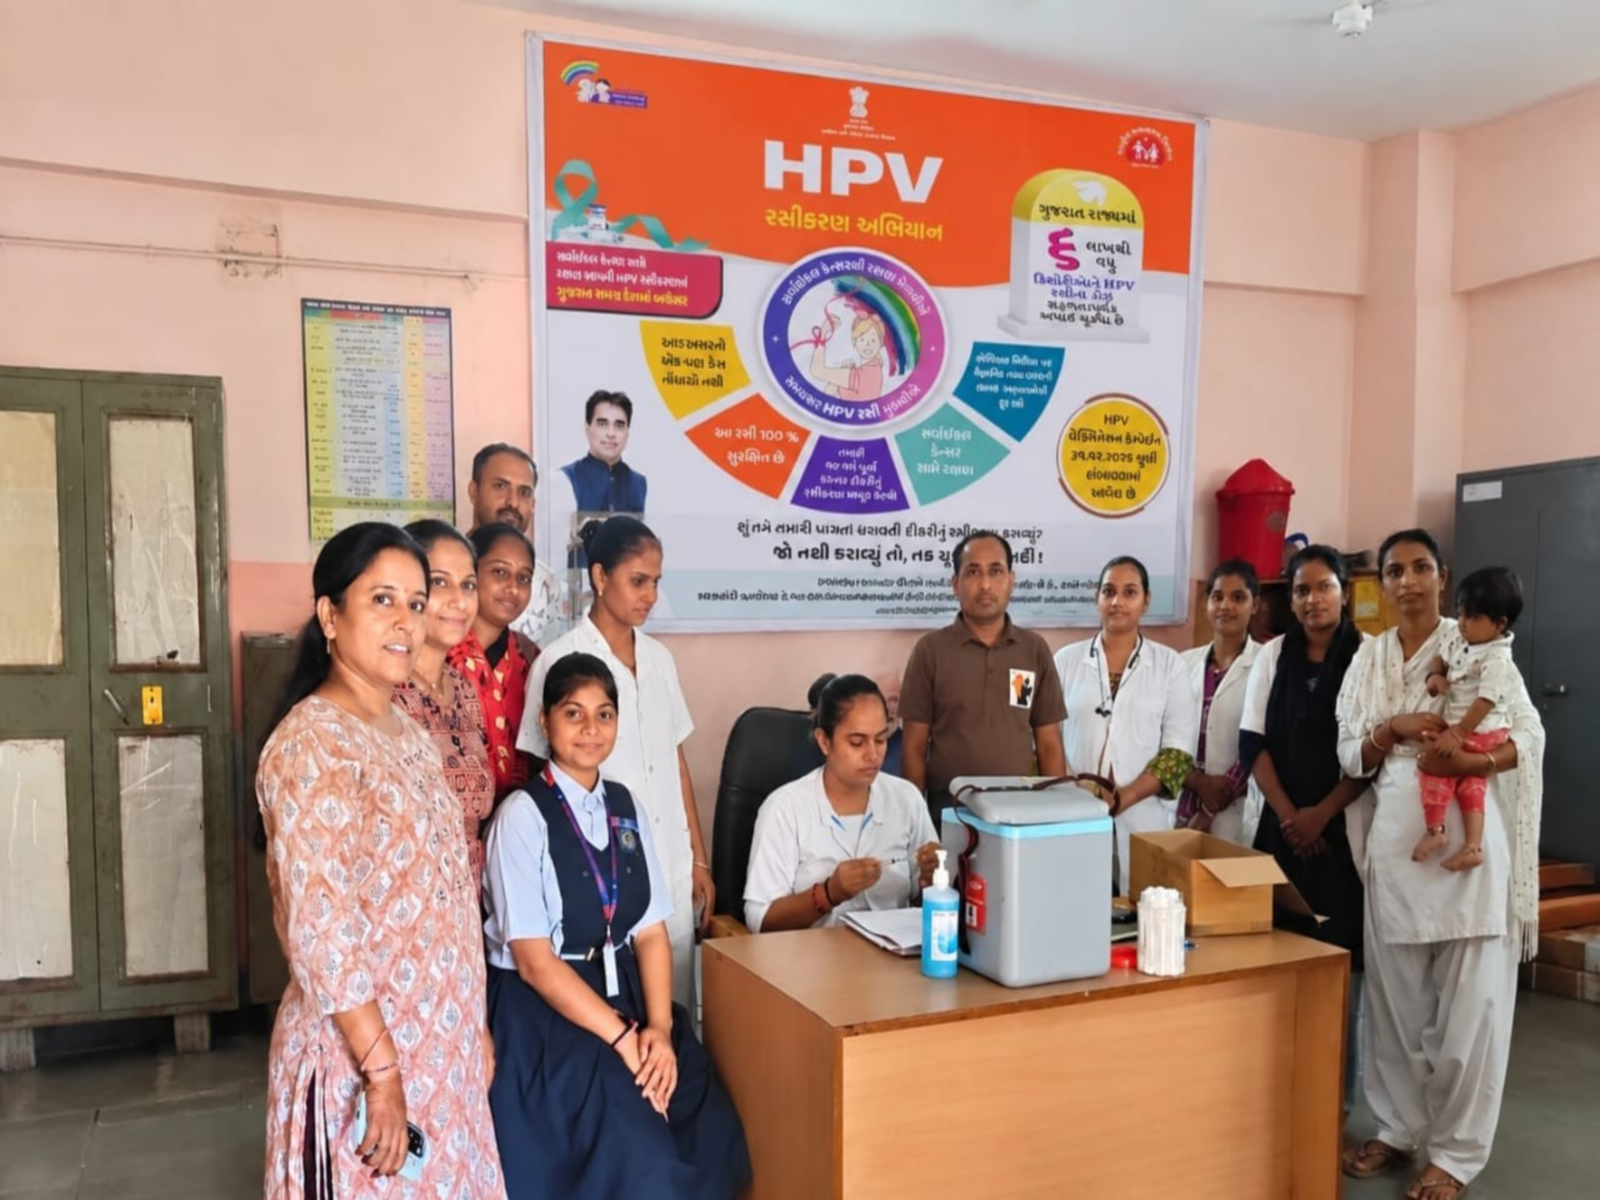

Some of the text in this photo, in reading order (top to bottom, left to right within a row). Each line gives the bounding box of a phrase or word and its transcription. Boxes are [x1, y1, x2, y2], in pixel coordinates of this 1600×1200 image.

[764, 139, 943, 203] HPV
[765, 204, 942, 241] રસીકરણ અભિયાન
[1039, 204, 1136, 224] ગુજરાત રાજ્યમાં
[616, 273, 638, 286] HPV
[1104, 279, 1135, 291] HPV
[701, 374, 723, 388] નથી
[823, 403, 855, 419] HPV
[857, 402, 881, 420] રસી
[1104, 414, 1129, 426] HPV
[714, 427, 732, 439] આ
[735, 424, 756, 440] રસી
[759, 430, 783, 442] 100
[773, 449, 785, 464] છે
[1125, 485, 1136, 499] છે
[737, 519, 750, 538] શું
[751, 519, 772, 534] તમે
[775, 519, 812, 535] તમારી
[856, 521, 901, 537] ધરાવતી
[905, 522, 946, 542] દીકરીનું
[773, 540, 792, 560] જો
[797, 542, 830, 561] નથી
[834, 544, 882, 567] કરાવ્યું
[886, 543, 907, 565] તો,
[911, 549, 934, 562] તક
